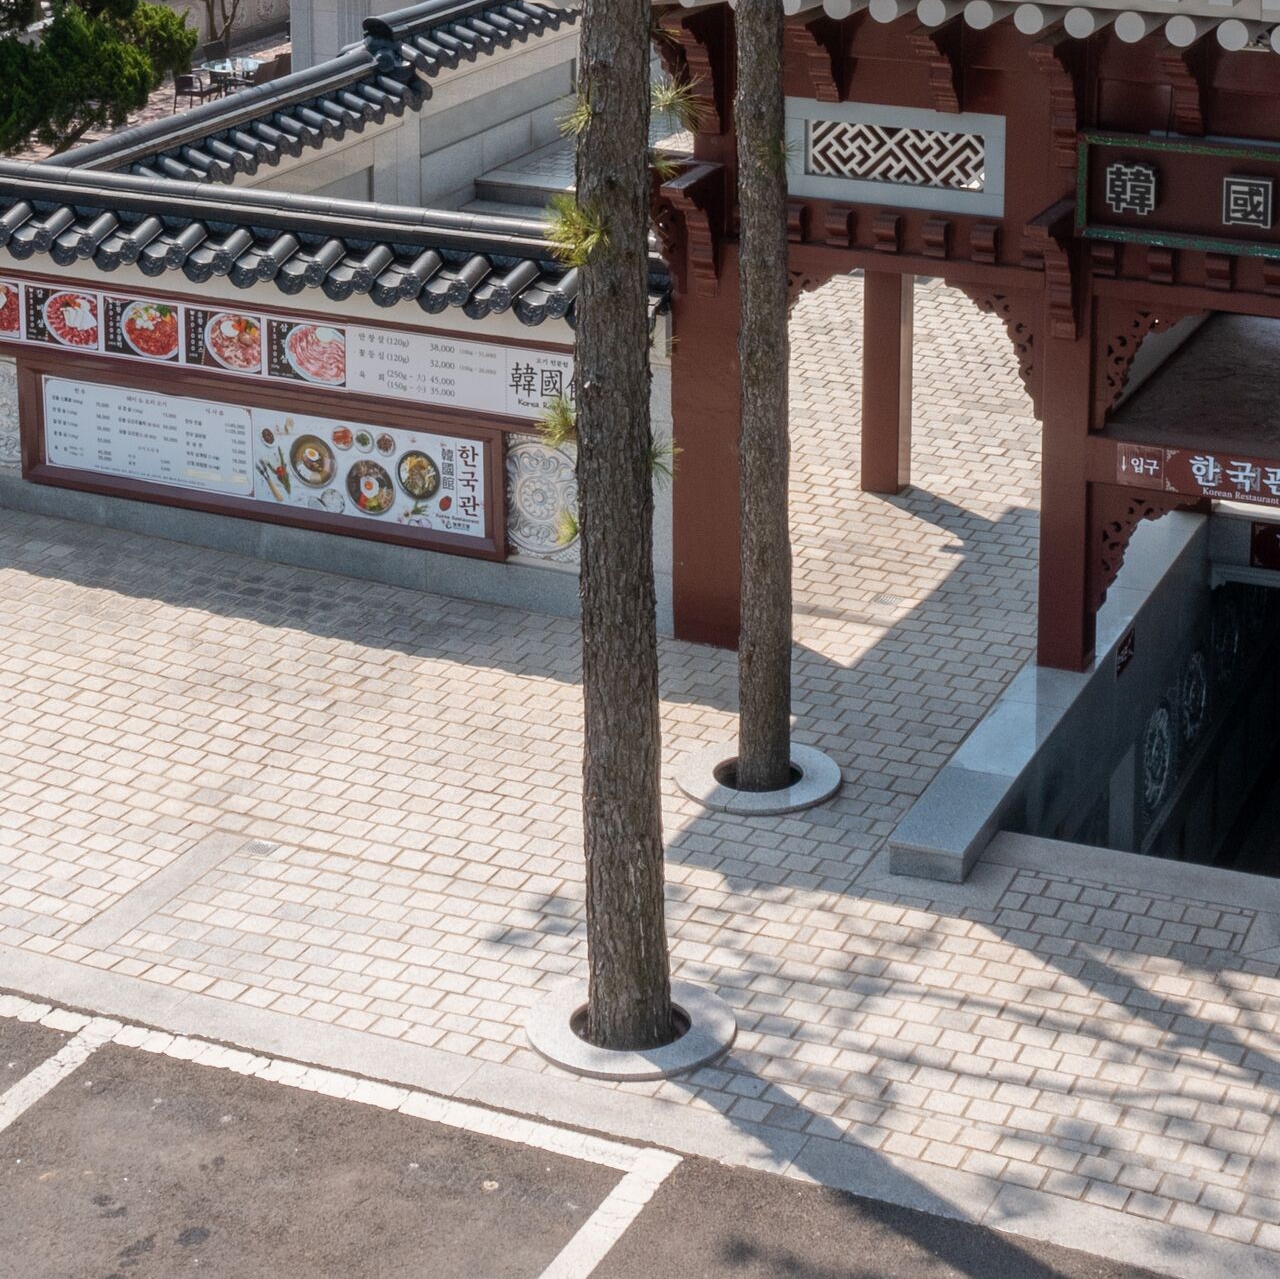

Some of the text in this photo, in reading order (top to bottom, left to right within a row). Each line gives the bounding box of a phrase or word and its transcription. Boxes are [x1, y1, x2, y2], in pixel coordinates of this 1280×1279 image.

[430, 343, 455, 354] 38,000
[430, 359, 455, 370] 32,000
[430, 375, 455, 386] 45,000
[1131, 457, 1159, 476] 입구
[457, 445, 480, 517] 한국관
[1202, 486, 1280, 505] Korean Restaurant
